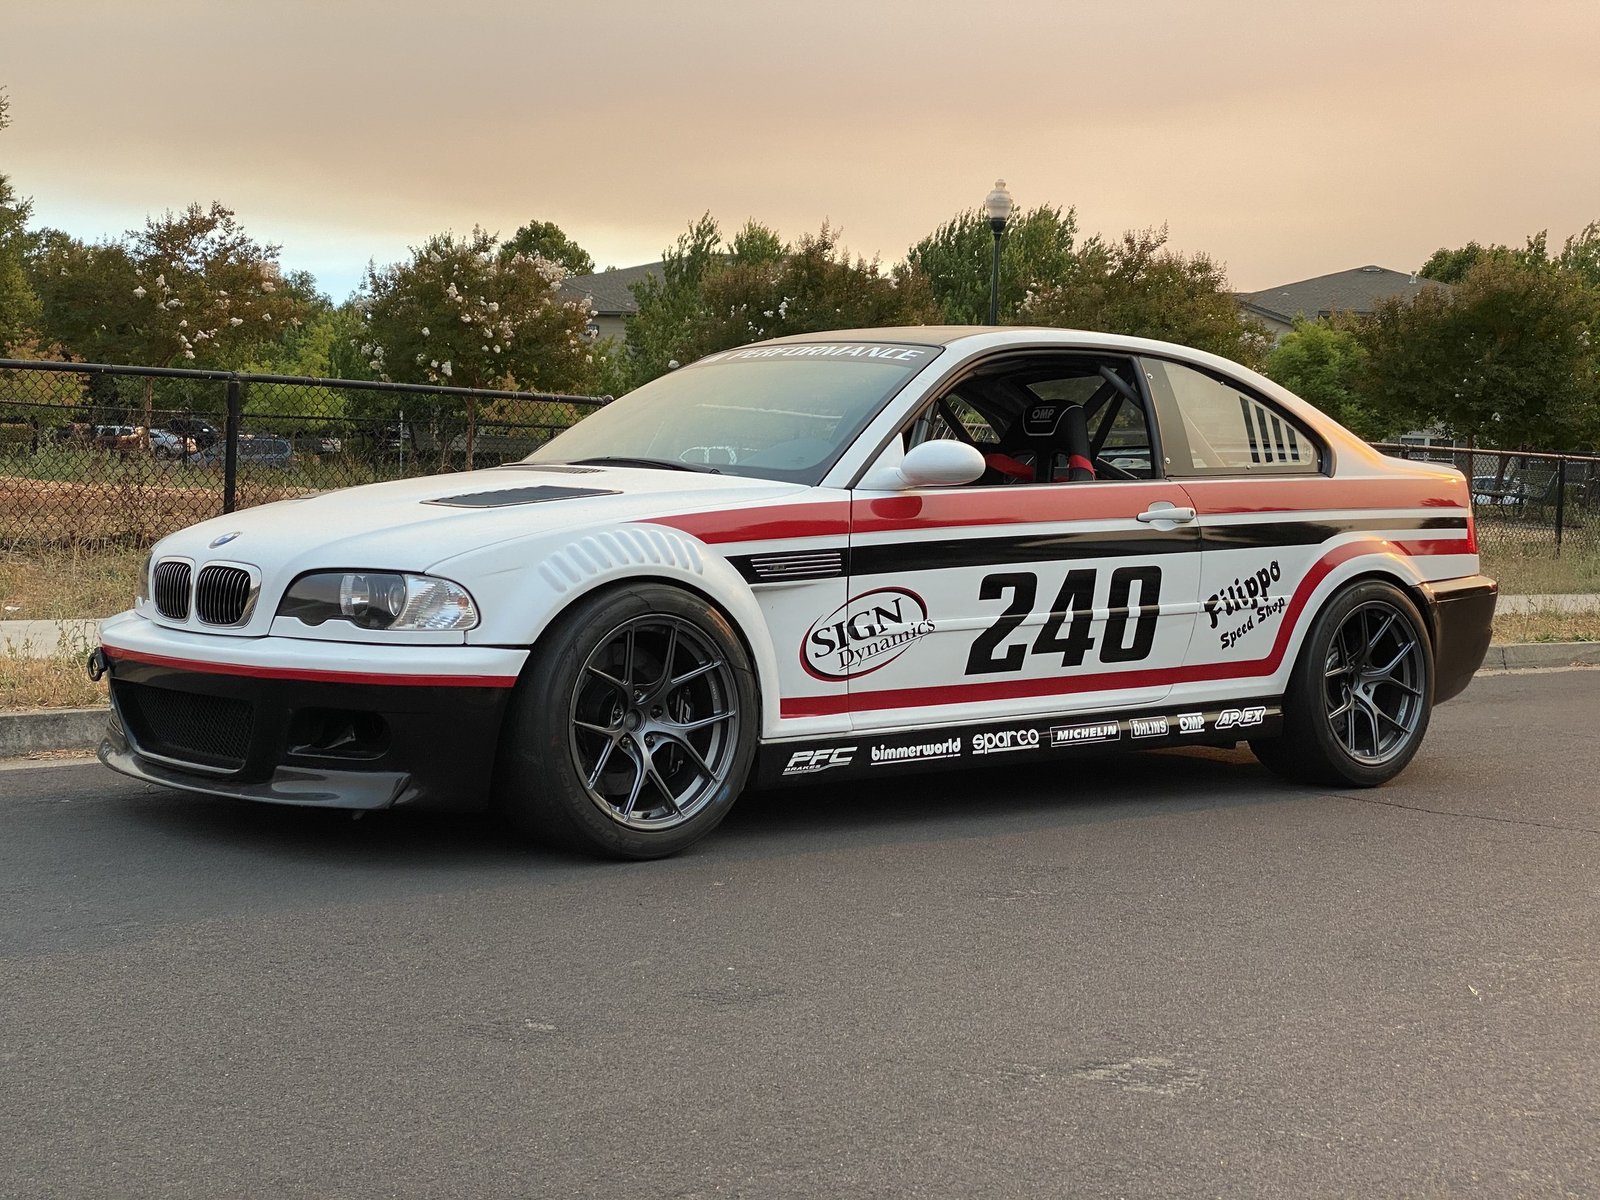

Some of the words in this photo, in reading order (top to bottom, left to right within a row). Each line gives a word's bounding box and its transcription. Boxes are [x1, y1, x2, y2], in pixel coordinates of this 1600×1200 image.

[727, 345, 925, 362] PERFORMANCE
[1031, 408, 1055, 420] OMP
[1203, 559, 1281, 629] Filippo
[811, 597, 902, 659] SIGN
[964, 565, 1163, 676] 240
[1220, 615, 1254, 650] Speed
[1256, 596, 1286, 624] Shop
[837, 618, 936, 669] Dynamics
[1056, 723, 1118, 741] MICHELIN
[1132, 718, 1167, 736] ÖHLINS
[1179, 716, 1206, 731] OMP
[871, 737, 962, 761] bimmerworld
[972, 728, 1040, 755] sparco
[784, 764, 822, 772] BRAKES
[786, 746, 858, 768] PFC
